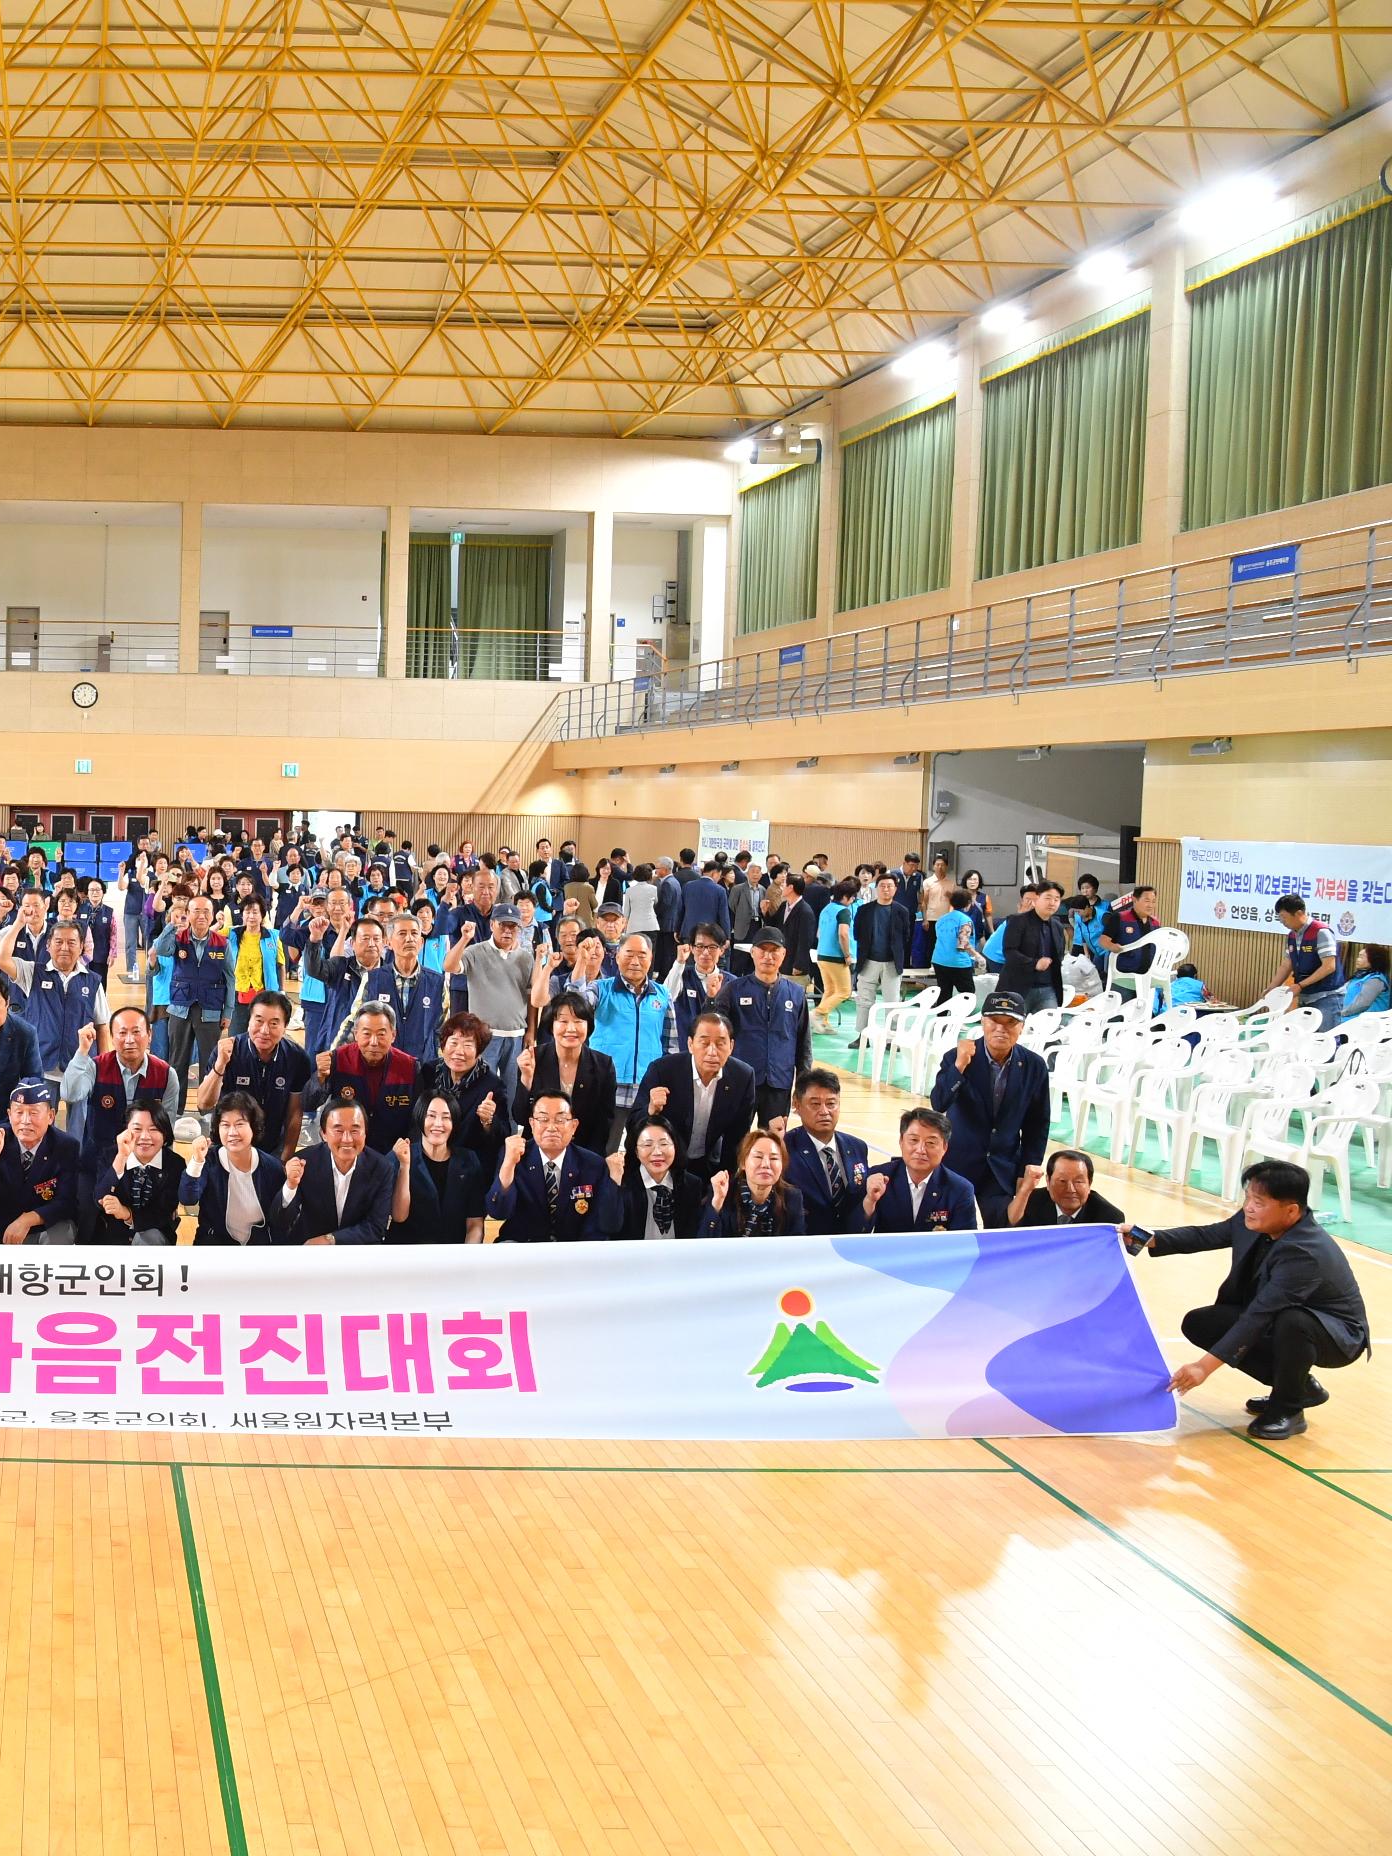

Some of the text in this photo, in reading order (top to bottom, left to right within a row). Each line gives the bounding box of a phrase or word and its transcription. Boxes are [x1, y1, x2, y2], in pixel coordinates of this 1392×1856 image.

[1314, 877, 1358, 903] 자부심을
[208, 951, 225, 960] 향군
[385, 1095, 411, 1107] 향군
[230, 1410, 454, 1432] 새울원자력본부
